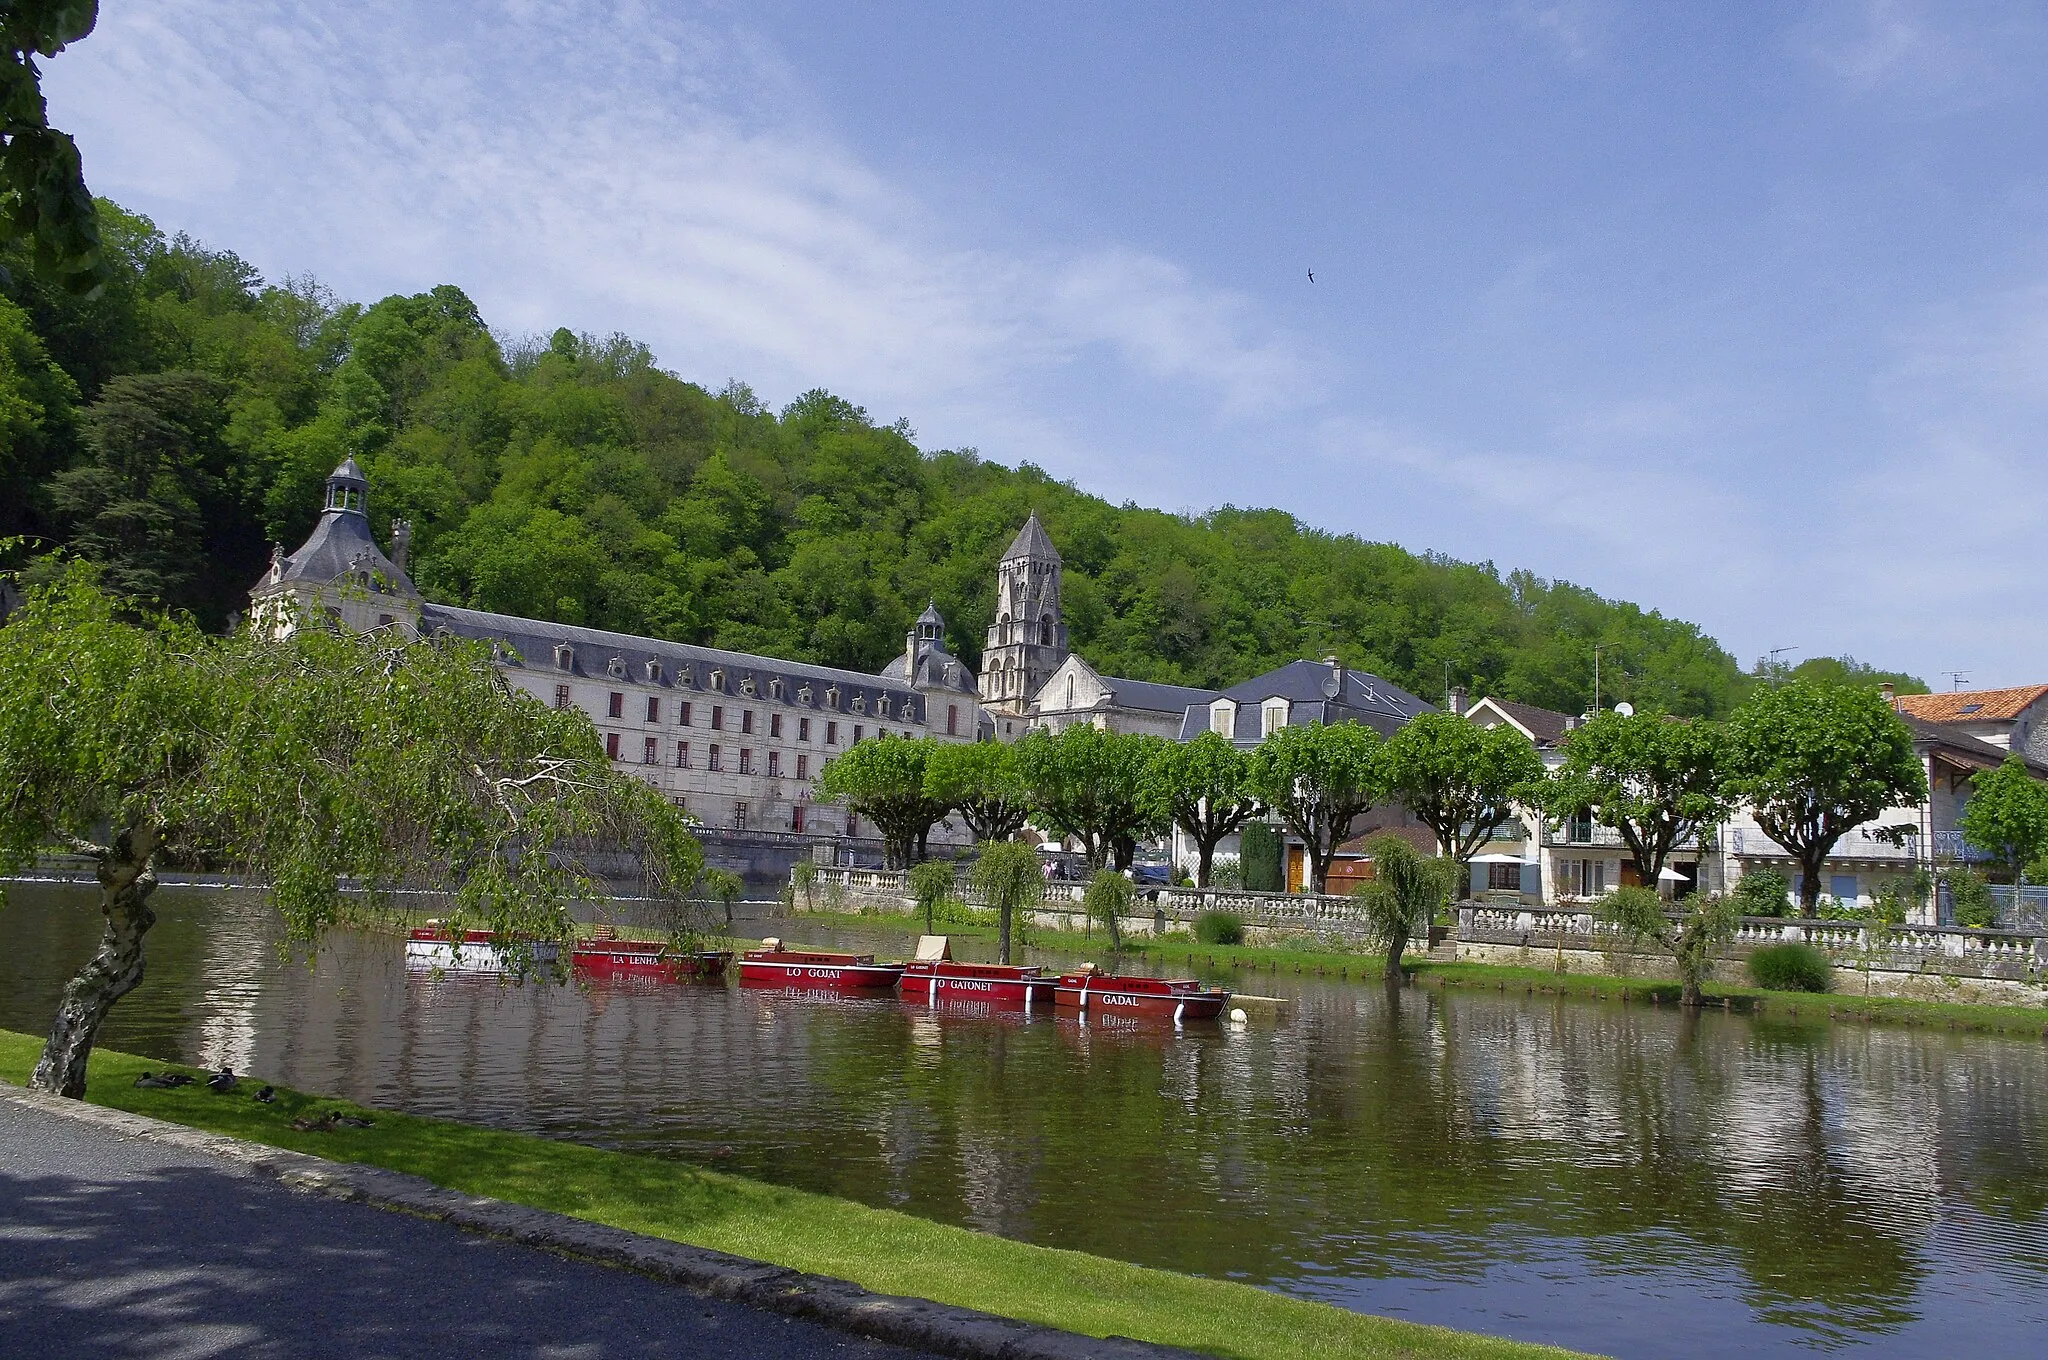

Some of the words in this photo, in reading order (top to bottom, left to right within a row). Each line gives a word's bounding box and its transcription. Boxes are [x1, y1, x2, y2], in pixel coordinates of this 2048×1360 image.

[612, 955, 624, 964] LA
[629, 956, 659, 966] LENHA
[786, 967, 802, 977] LO
[808, 968, 842, 979] GOJAT
[936, 979, 945, 988] O
[950, 980, 992, 992] GATONET
[1102, 994, 1139, 1007] GADAL
